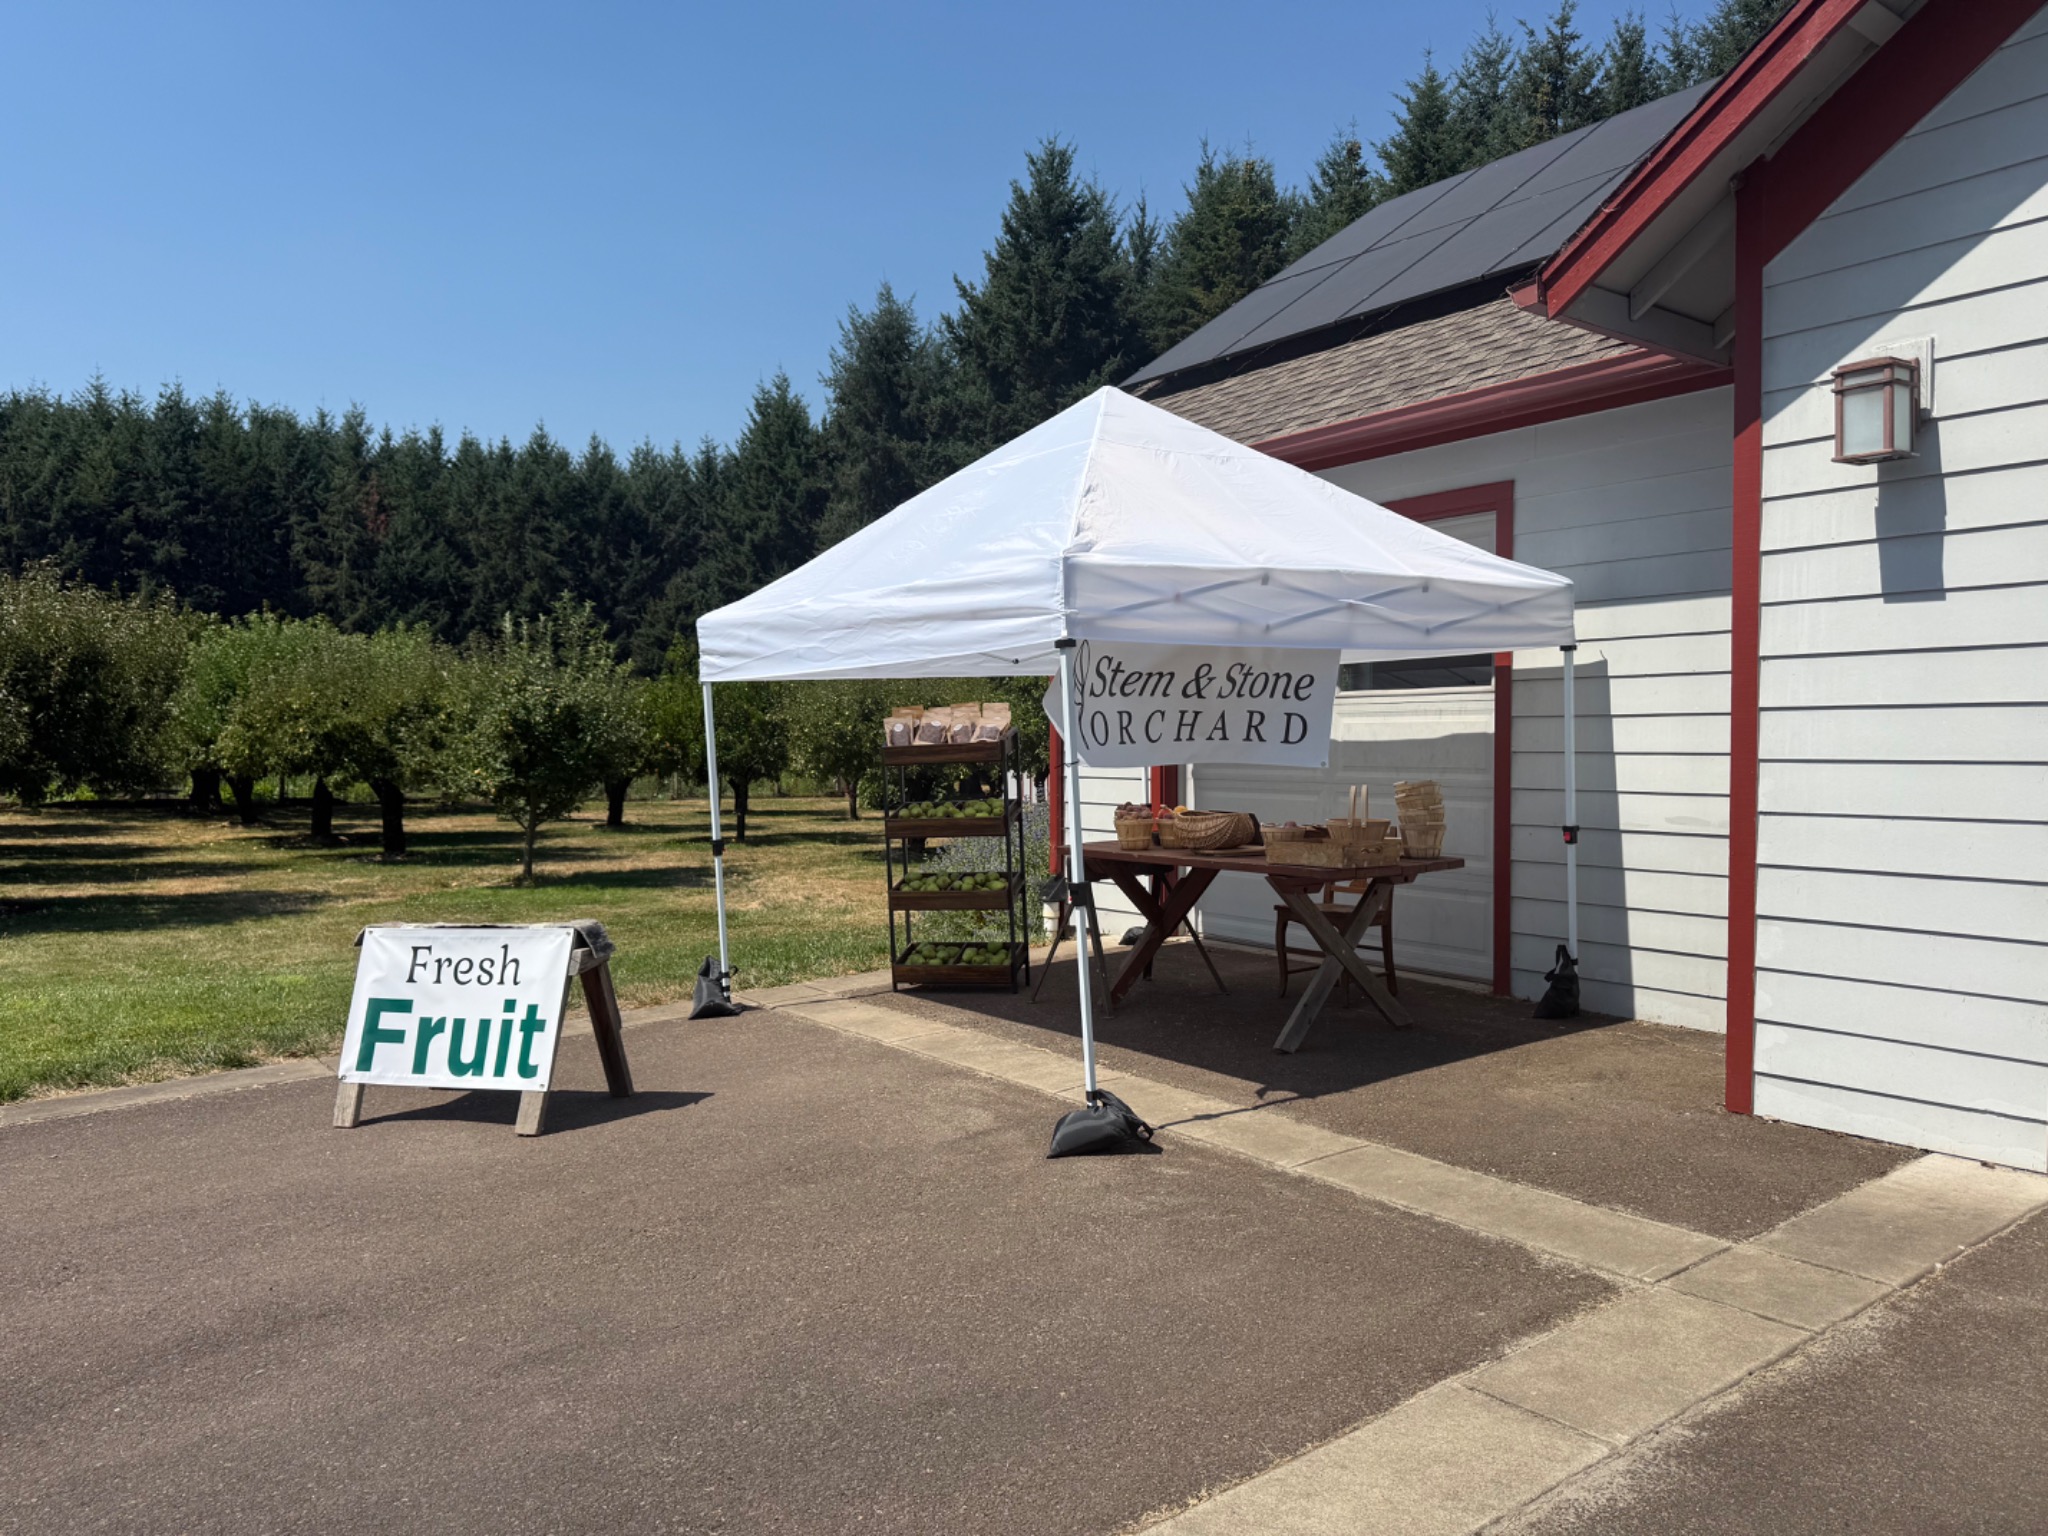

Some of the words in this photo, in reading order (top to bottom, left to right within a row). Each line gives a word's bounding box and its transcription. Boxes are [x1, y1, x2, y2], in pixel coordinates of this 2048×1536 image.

[1089, 655, 1176, 698] Stem
[1181, 663, 1217, 699] &
[1216, 662, 1315, 702] Stone
[1090, 709, 1308, 747] ORCHARD
[405, 943, 521, 986] Fresh
[355, 997, 547, 1079] Fruit
